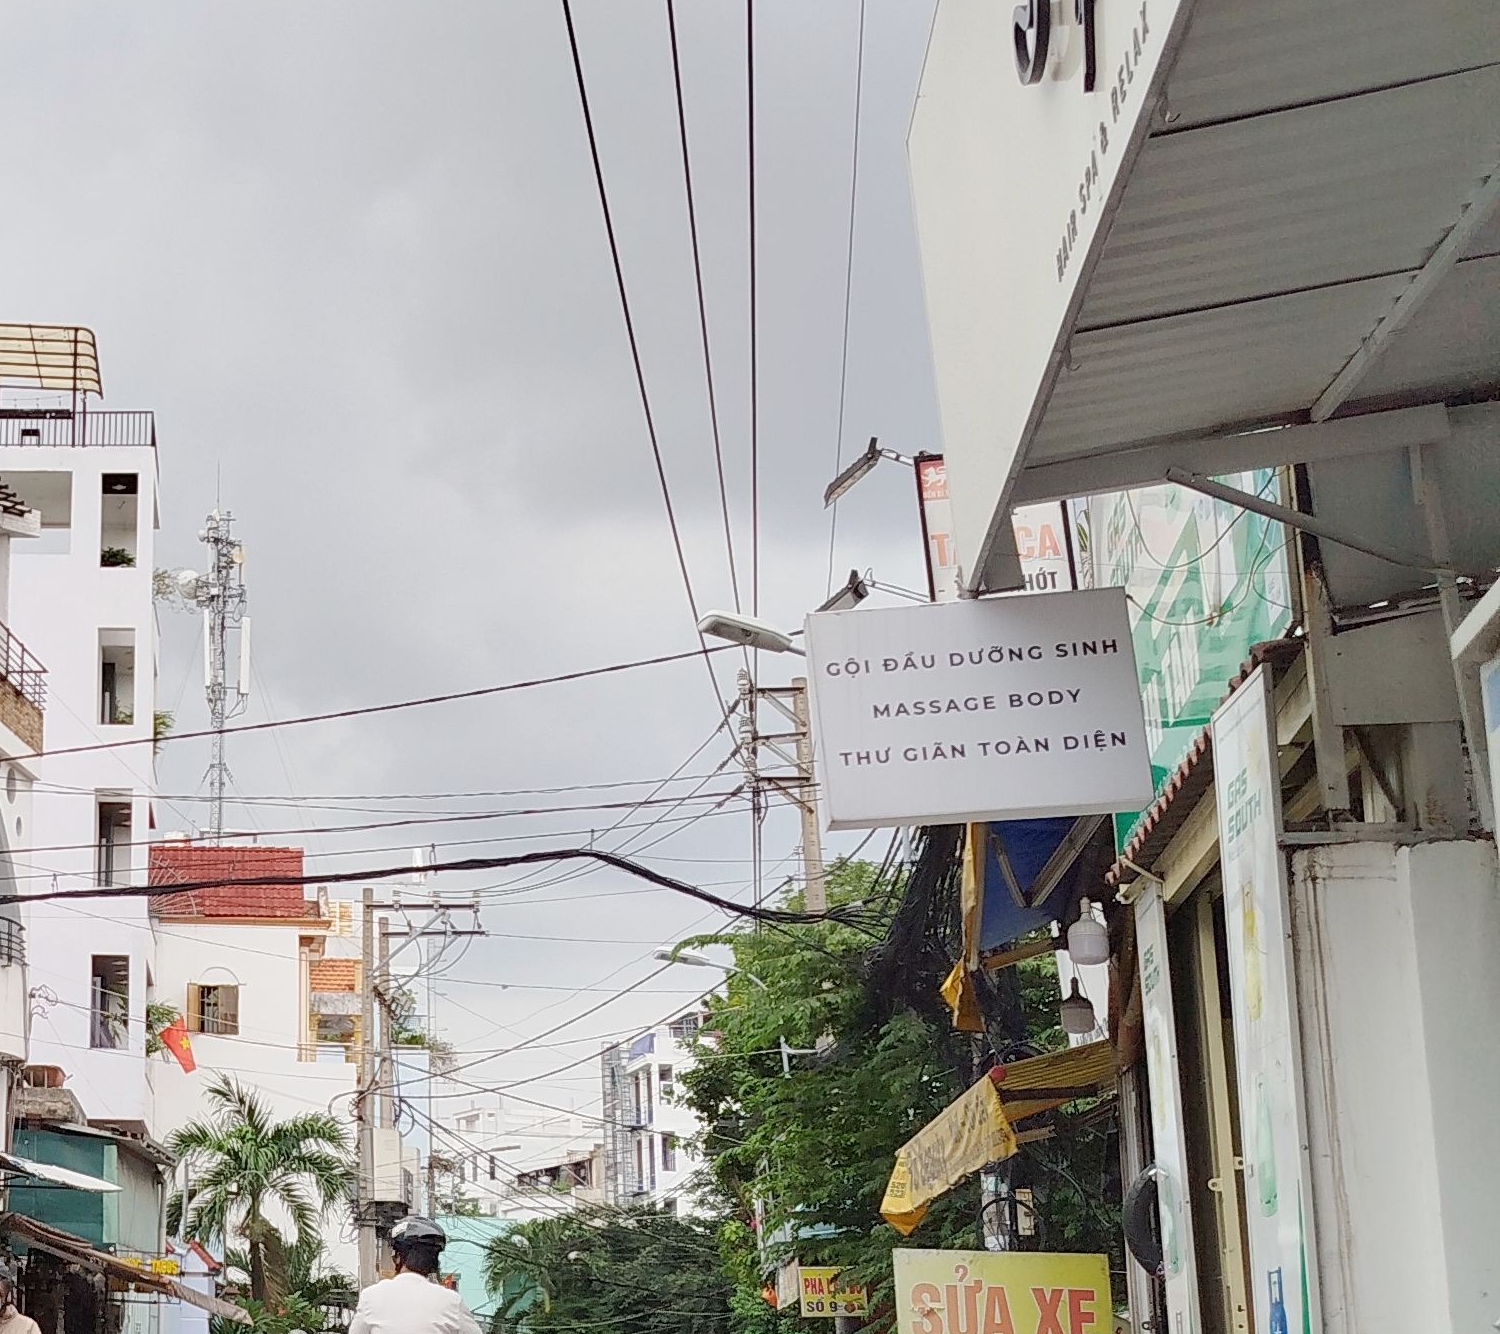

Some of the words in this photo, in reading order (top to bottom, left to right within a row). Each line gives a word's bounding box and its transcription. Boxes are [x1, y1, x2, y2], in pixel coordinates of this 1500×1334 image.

[1055, 210, 1079, 283] HAIR
[1079, 149, 1099, 216] SPA
[1109, 0, 1151, 126] RELAX
[825, 657, 871, 678] GỘI
[882, 651, 935, 672] ĐẦU
[949, 645, 1044, 667] DƯỠNG
[1055, 638, 1119, 658] SINH
[872, 695, 997, 719] MASSAGE
[1008, 688, 1082, 708] BODY
[839, 746, 891, 767] THƯ
[902, 742, 966, 763] GIÃN
[977, 735, 1050, 757] TOÀN
[1063, 729, 1128, 753] DIỆN
[1227, 767, 1247, 810] GAS
[1228, 788, 1261, 845] SOUTH
